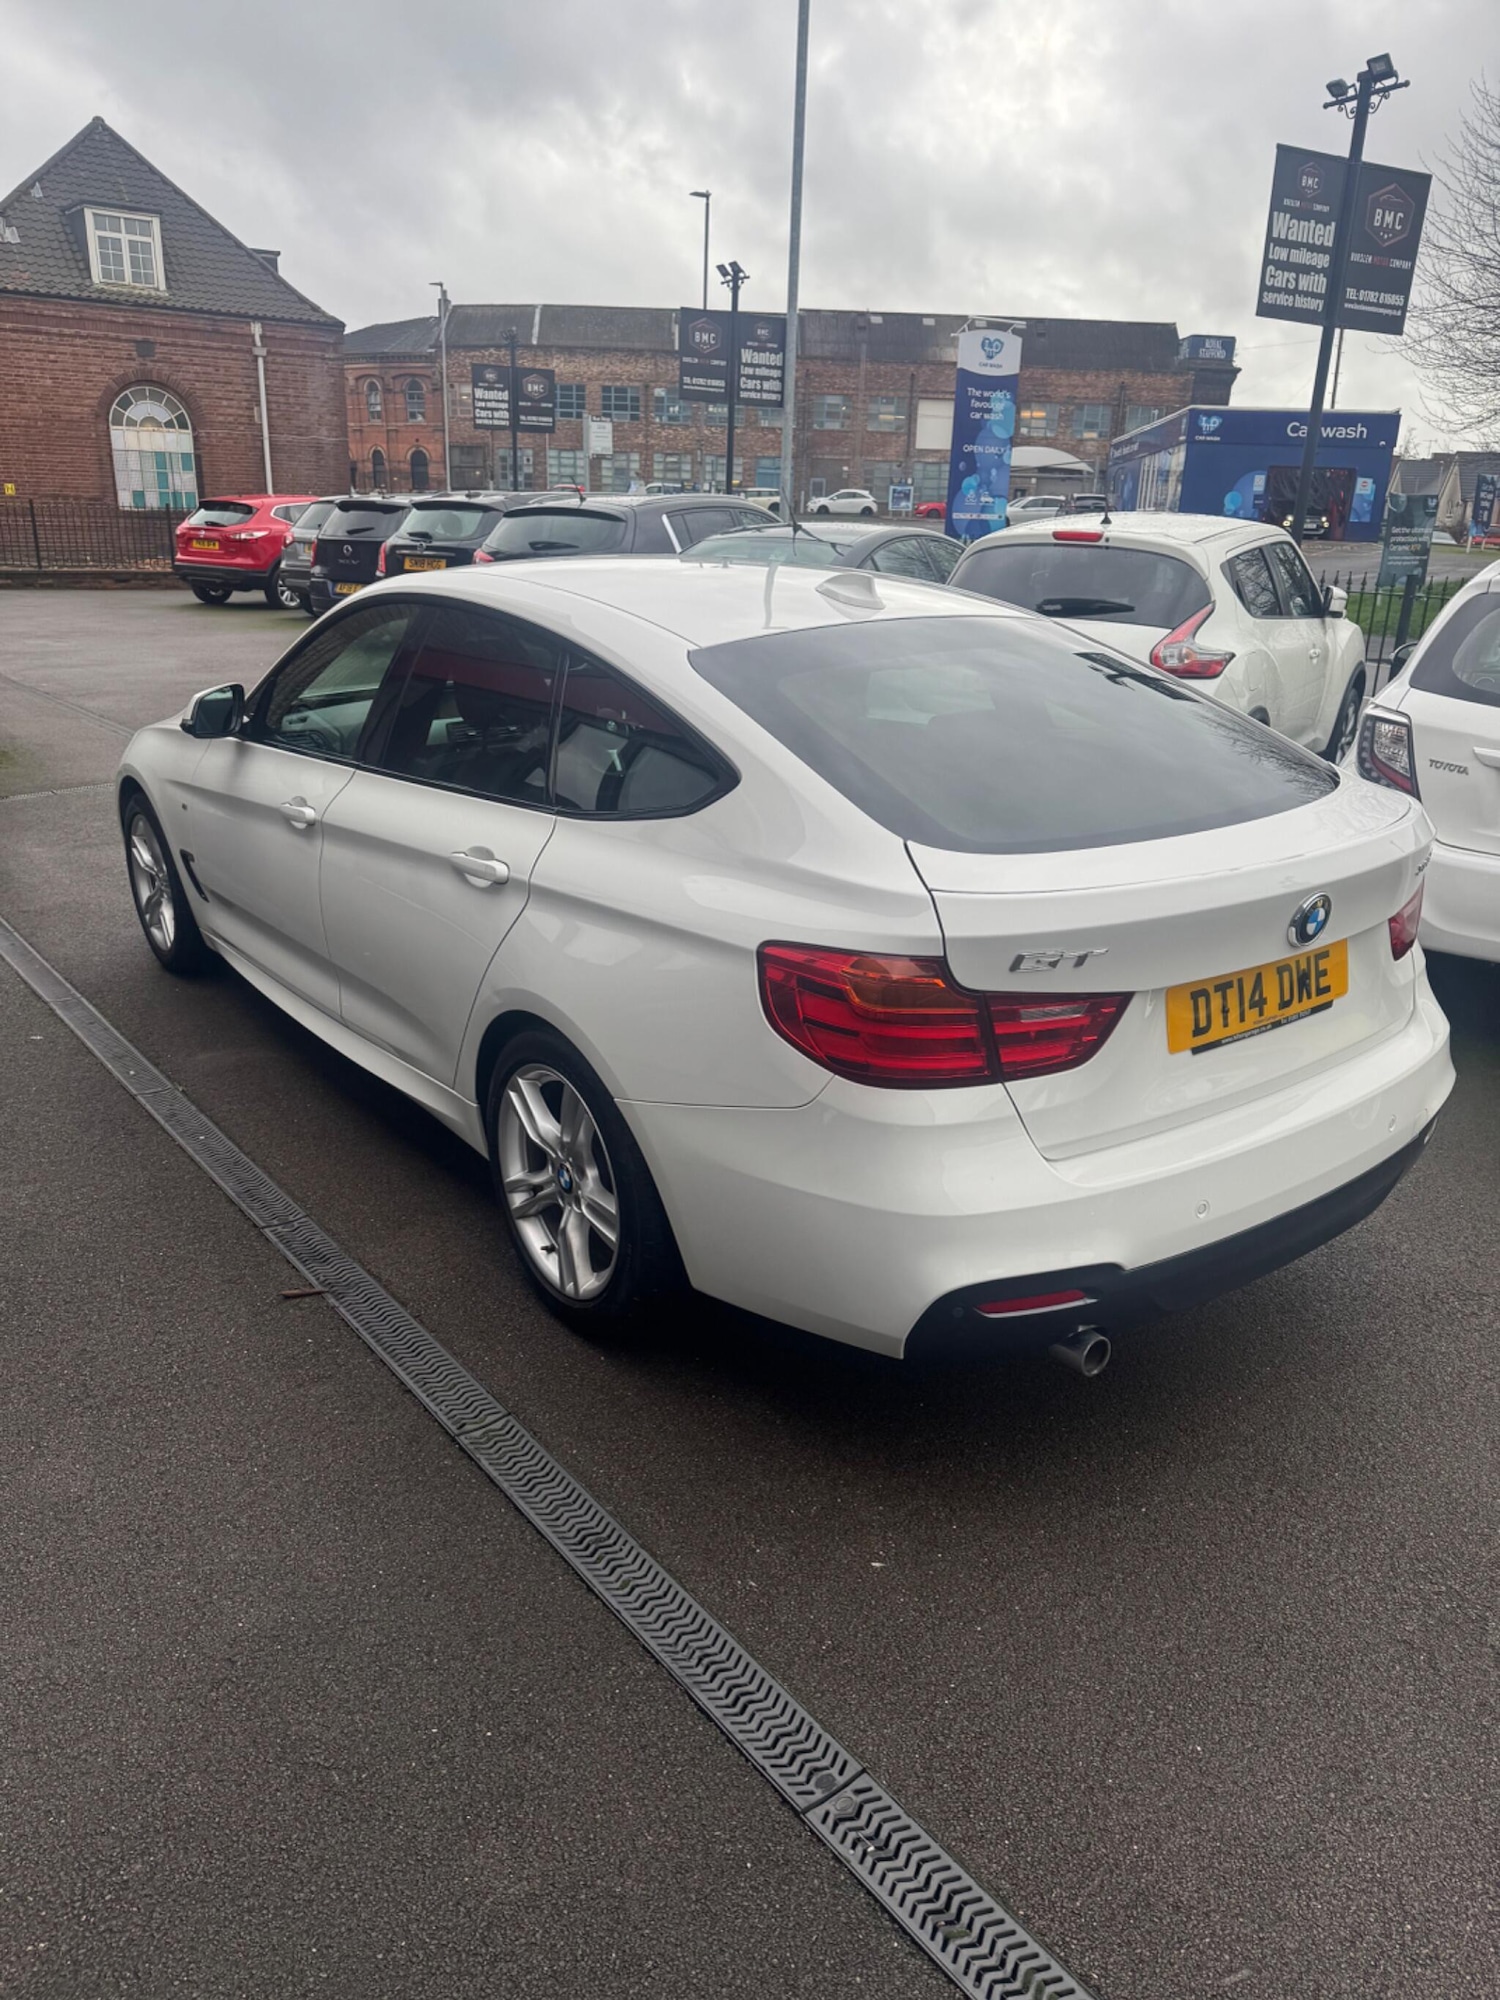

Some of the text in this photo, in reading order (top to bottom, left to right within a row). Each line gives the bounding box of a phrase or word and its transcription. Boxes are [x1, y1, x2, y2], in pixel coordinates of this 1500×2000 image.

[1302, 175, 1319, 189] BMC
[1373, 208, 1405, 230] BMC
[1272, 211, 1336, 247] Wanted
[1268, 242, 1330, 268] Low mileage
[1265, 265, 1328, 294] Cars with
[1262, 291, 1294, 307] service
[1294, 294, 1325, 312] history
[741, 348, 784, 366] Wanted
[740, 365, 782, 378] Low mileage
[740, 377, 761, 390] Cars
[762, 379, 782, 391] with
[967, 387, 1011, 399] The world's
[474, 388, 509, 400] Wanted
[970, 411, 1005, 420] car wash
[1286, 421, 1368, 439] Ca wash
[962, 444, 1005, 455] OPEN DAILY
[1428, 758, 1469, 775] TOYOTA
[1008, 949, 1109, 973] GT
[1190, 950, 1331, 1038] DT14 DWE
